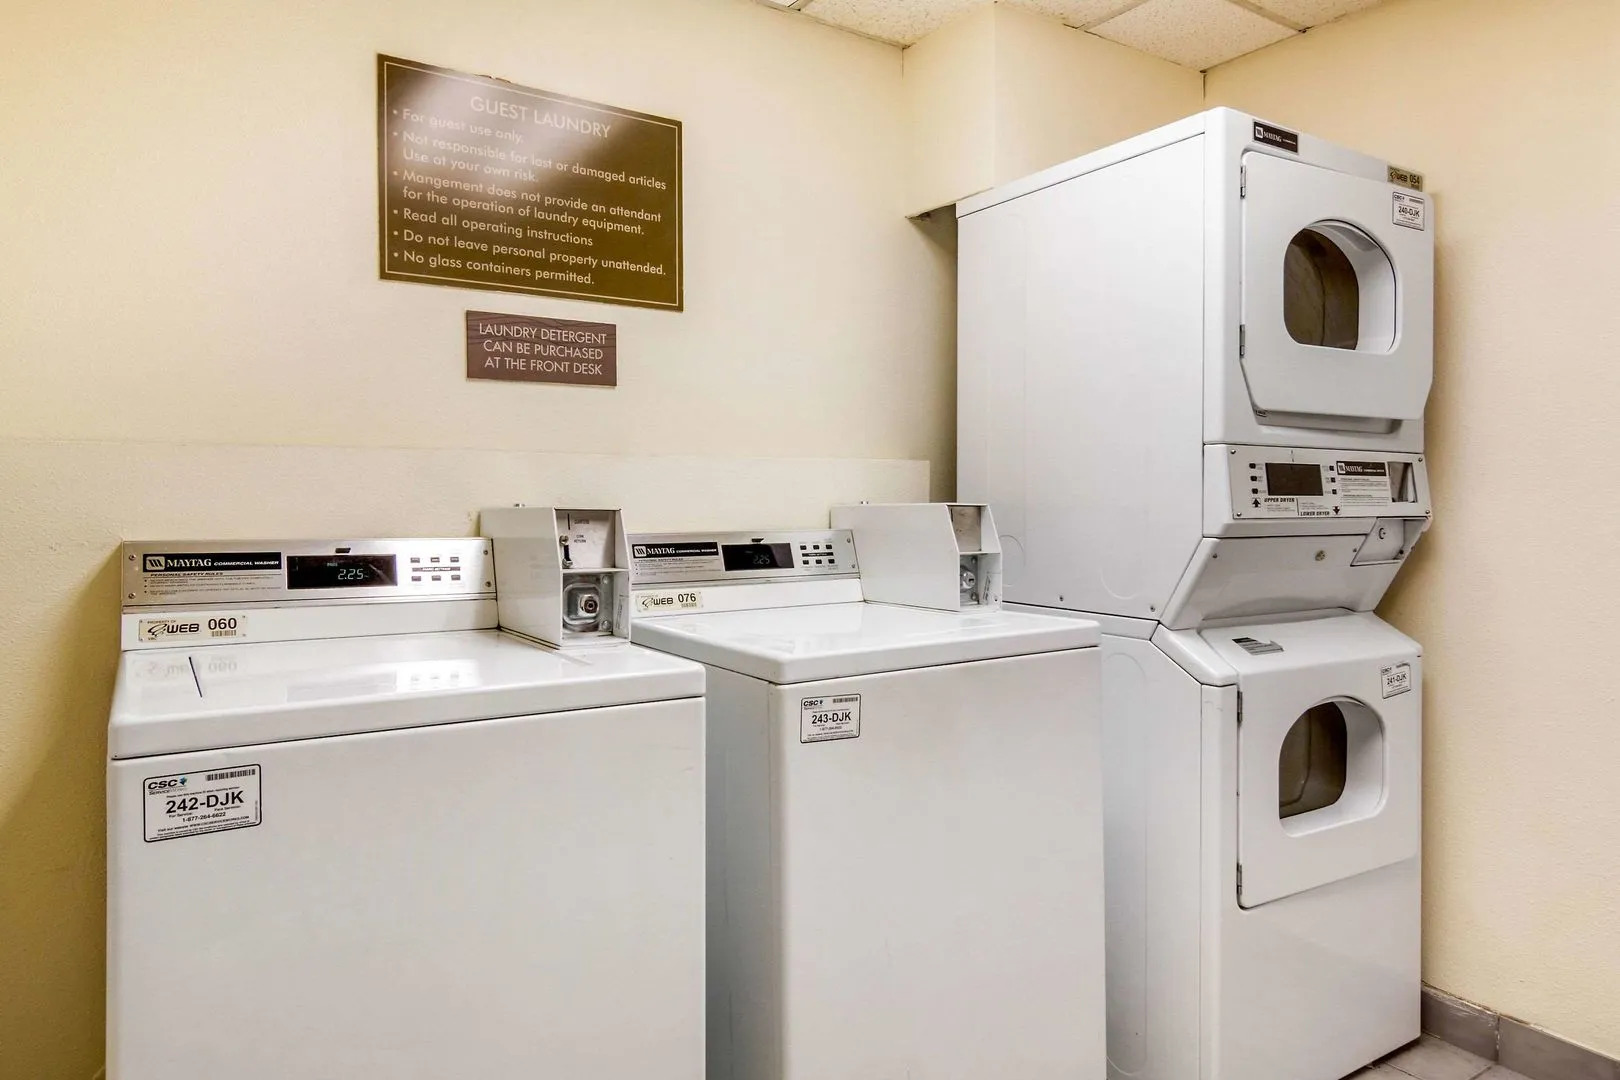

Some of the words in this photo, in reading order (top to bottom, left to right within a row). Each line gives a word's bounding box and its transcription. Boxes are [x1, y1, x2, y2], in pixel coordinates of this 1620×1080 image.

[402, 108, 424, 122] For
[430, 116, 466, 131] guest
[470, 125, 492, 136] use
[495, 129, 524, 144] only.
[470, 96, 528, 121] GUEST
[534, 110, 611, 138] LAUNDRY
[402, 131, 428, 145] Not
[432, 138, 506, 160] responsible
[510, 150, 528, 164] for
[556, 162, 568, 172] or
[572, 163, 626, 182] damaged
[629, 175, 666, 190] articles
[402, 147, 428, 162] Use
[433, 156, 446, 166] at
[450, 160, 480, 172] your
[484, 164, 510, 178] own
[514, 168, 539, 183] risk.
[1410, 174, 1420, 184] 054
[402, 170, 482, 192] Mangement
[487, 184, 517, 199] does
[521, 192, 540, 202] not
[544, 195, 588, 210] provide
[592, 202, 606, 213] an
[610, 206, 662, 222] attendant
[402, 186, 422, 200] for
[426, 190, 448, 204] the
[452, 197, 514, 214] operation
[518, 206, 530, 217] of
[534, 207, 578, 227] laundry
[582, 218, 644, 235] equipment.
[403, 208, 437, 224] Read
[442, 214, 457, 226] all
[462, 220, 523, 239] operating
[528, 226, 594, 246] instructions
[403, 229, 424, 242] Do
[428, 236, 450, 246] not
[454, 236, 488, 252] leave
[492, 244, 546, 260] personal
[550, 252, 598, 268] property
[601, 259, 666, 276] unattended.
[403, 250, 424, 264] No
[429, 254, 462, 268] glass
[466, 261, 532, 278] containers
[536, 269, 594, 285] permitted.
[480, 323, 538, 338] LAUNDRY
[540, 328, 607, 344] DETERGENT
[483, 340, 512, 353] CAN
[516, 342, 530, 354] BE
[534, 344, 604, 360] PURCHASED
[484, 356, 500, 369] AT
[504, 357, 526, 370] THE
[530, 360, 570, 372] FRONT
[574, 362, 602, 375] DESK
[166, 558, 212, 568] MAYTAG
[338, 568, 364, 580] 2.25
[654, 597, 674, 606] WEB
[678, 593, 696, 602] 076
[166, 624, 200, 633] WEB
[208, 618, 237, 630] 060
[812, 712, 851, 724] 243-DJK
[148, 779, 178, 790] CSC
[166, 790, 244, 814] 242-DJK
